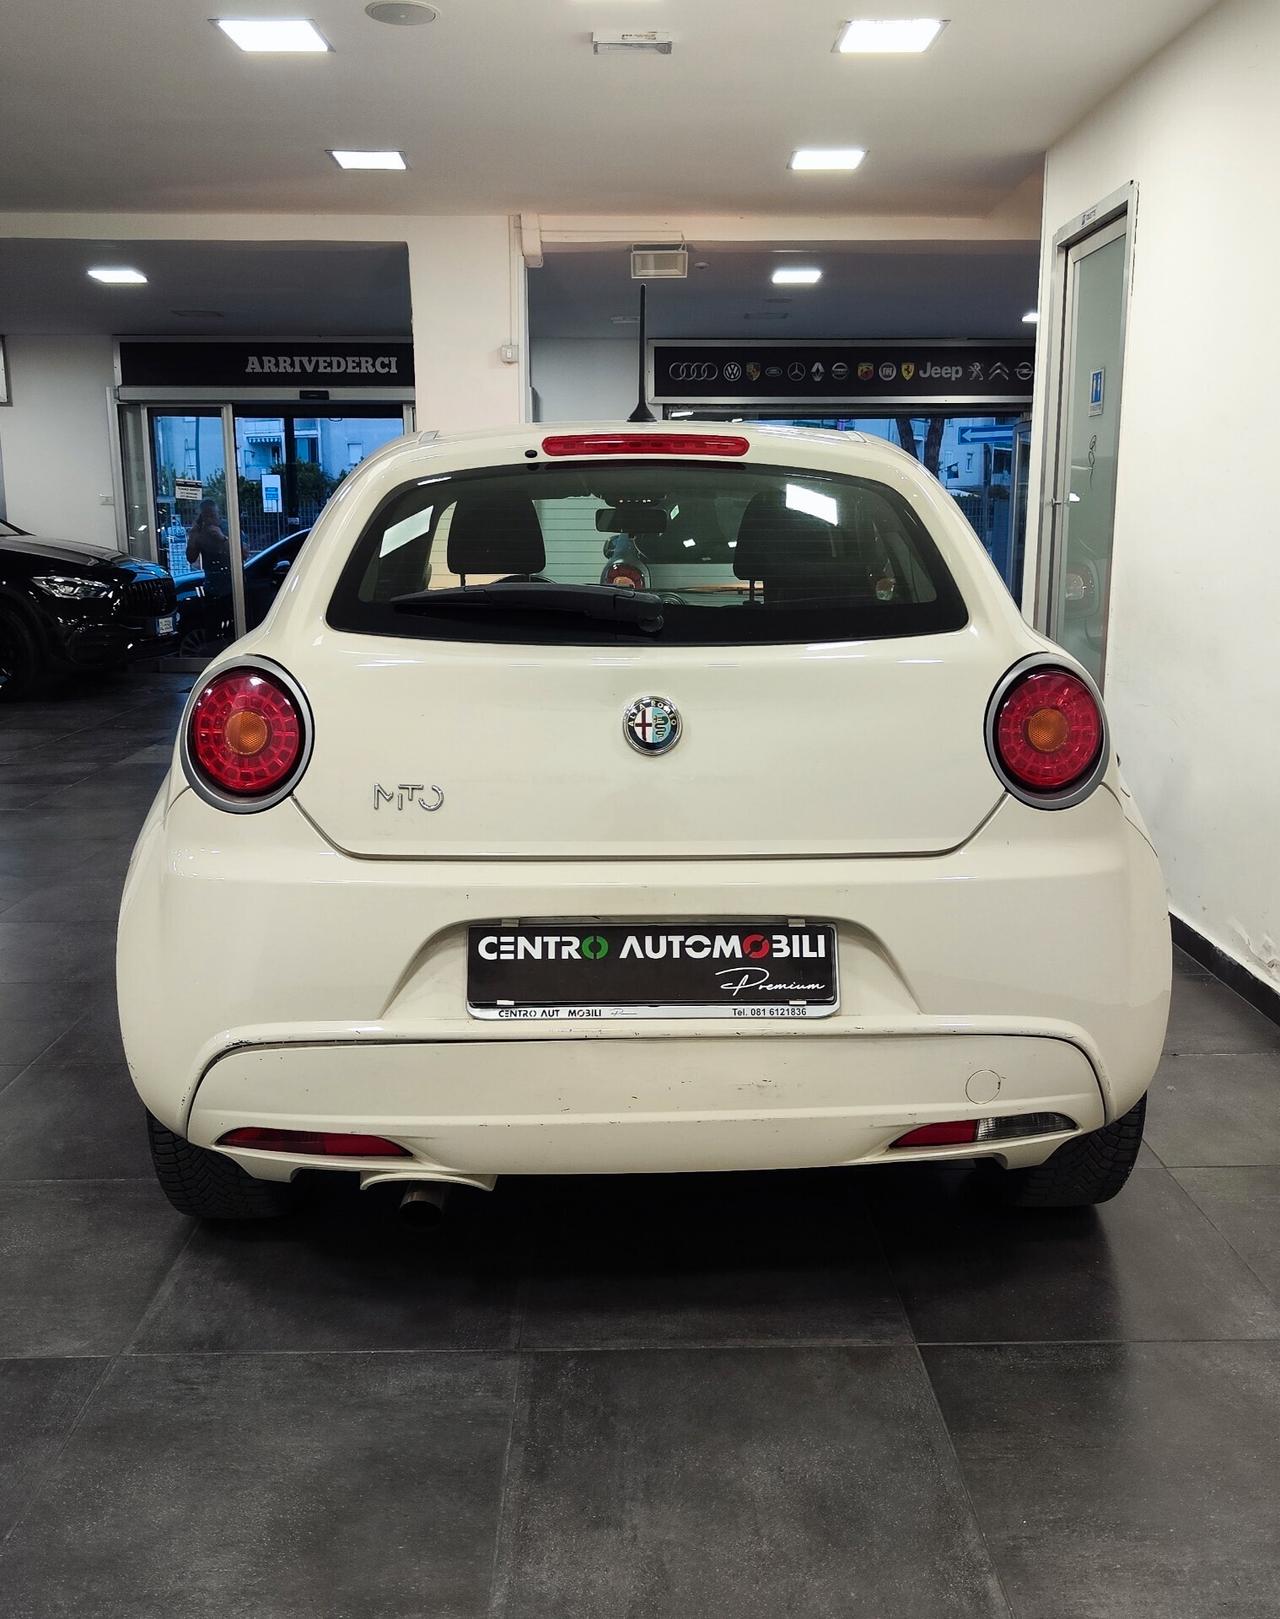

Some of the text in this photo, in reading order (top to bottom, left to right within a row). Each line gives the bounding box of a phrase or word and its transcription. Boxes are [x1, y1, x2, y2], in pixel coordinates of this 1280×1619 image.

[245, 356, 398, 374] ARRIVEDERCI
[919, 362, 963, 381] Jeep
[478, 933, 826, 960] CENTRO AUTOMOBILI
[714, 966, 825, 996] Premium
[498, 1009, 537, 1018] CENTRO
[732, 1007, 807, 1016] Tel. 081 6121836
